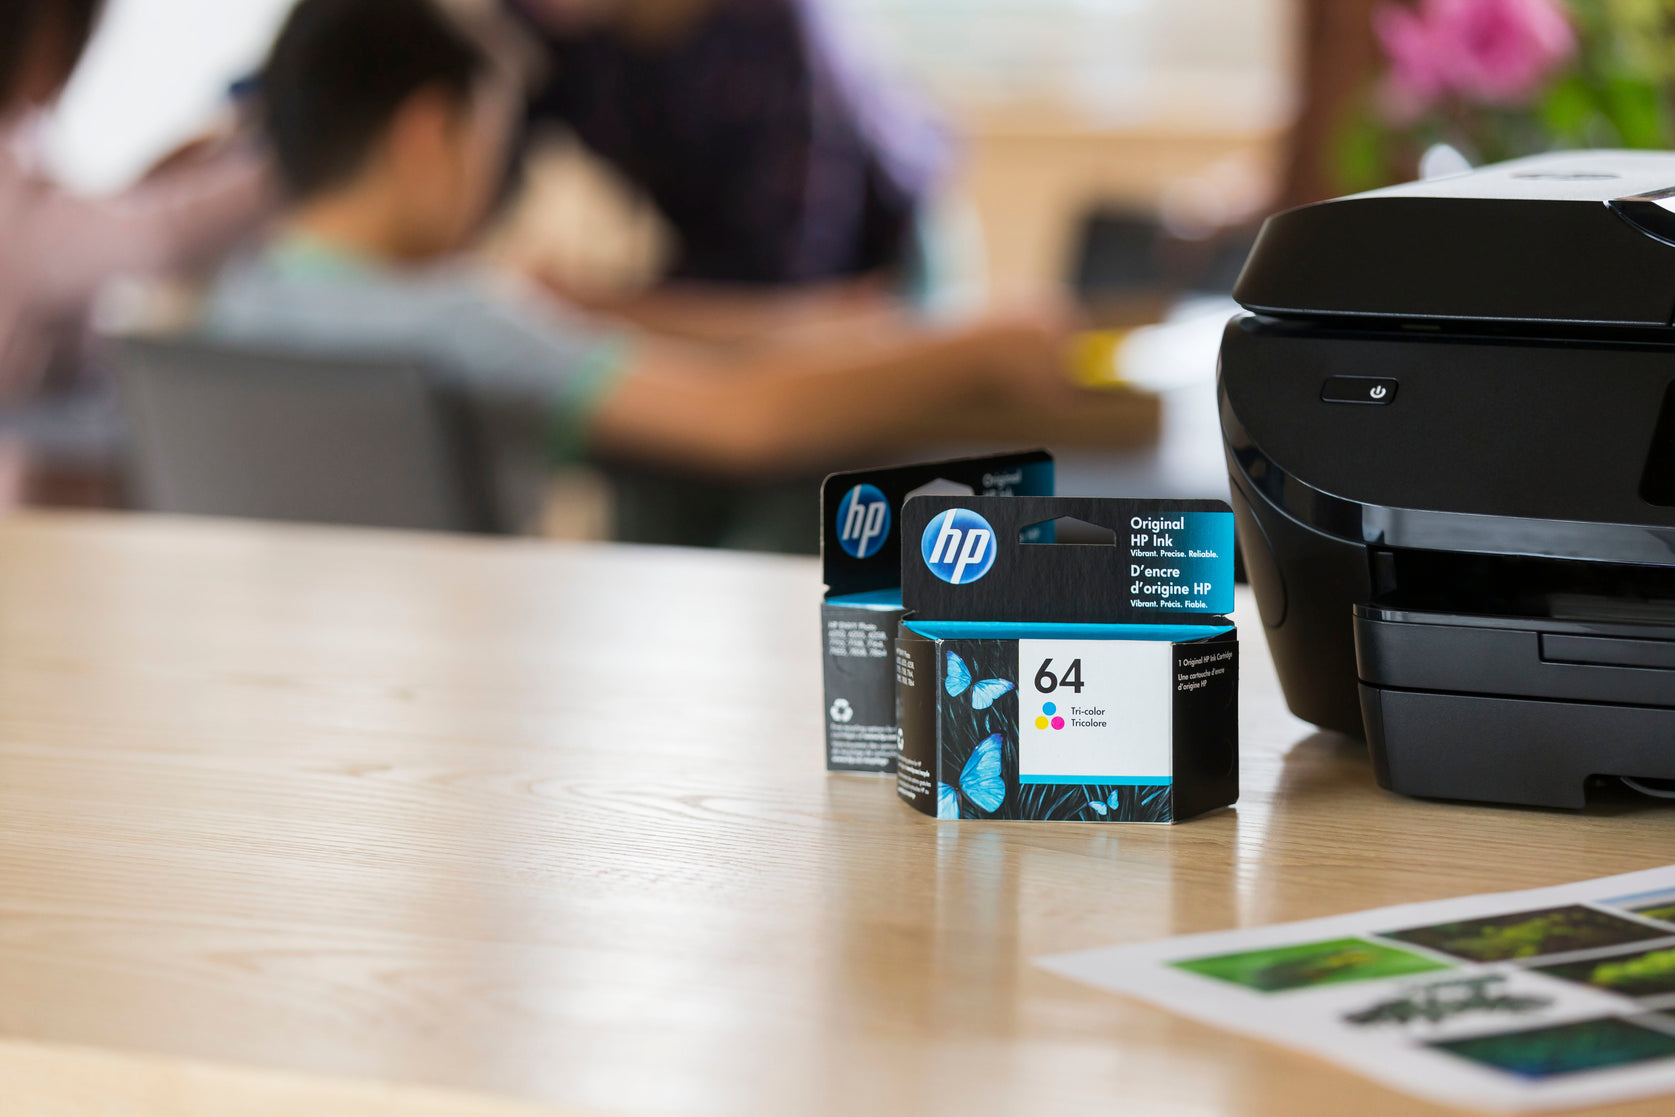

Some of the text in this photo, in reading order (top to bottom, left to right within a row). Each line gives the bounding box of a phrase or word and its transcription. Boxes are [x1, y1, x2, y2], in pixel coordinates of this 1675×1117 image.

[842, 484, 886, 559] hp
[1130, 516, 1184, 533] Original
[1130, 533, 1173, 546] HP Ink
[929, 508, 990, 584] hp
[1130, 549, 1219, 558] Vibrant. Precise. Reliable.
[1193, 583, 1212, 595] HP
[1130, 599, 1208, 609] Vibrant. Précis. Fiable.
[1178, 659, 1182, 667] 1
[1183, 656, 1203, 667] Original
[1203, 655, 1210, 663] HP
[1034, 658, 1085, 694] 64
[1178, 673, 1189, 681] Une
[1190, 669, 1211, 680] cartouche
[1200, 679, 1207, 688] HP
[1071, 706, 1106, 716] Tri-color
[1071, 718, 1107, 728] Tricolore
